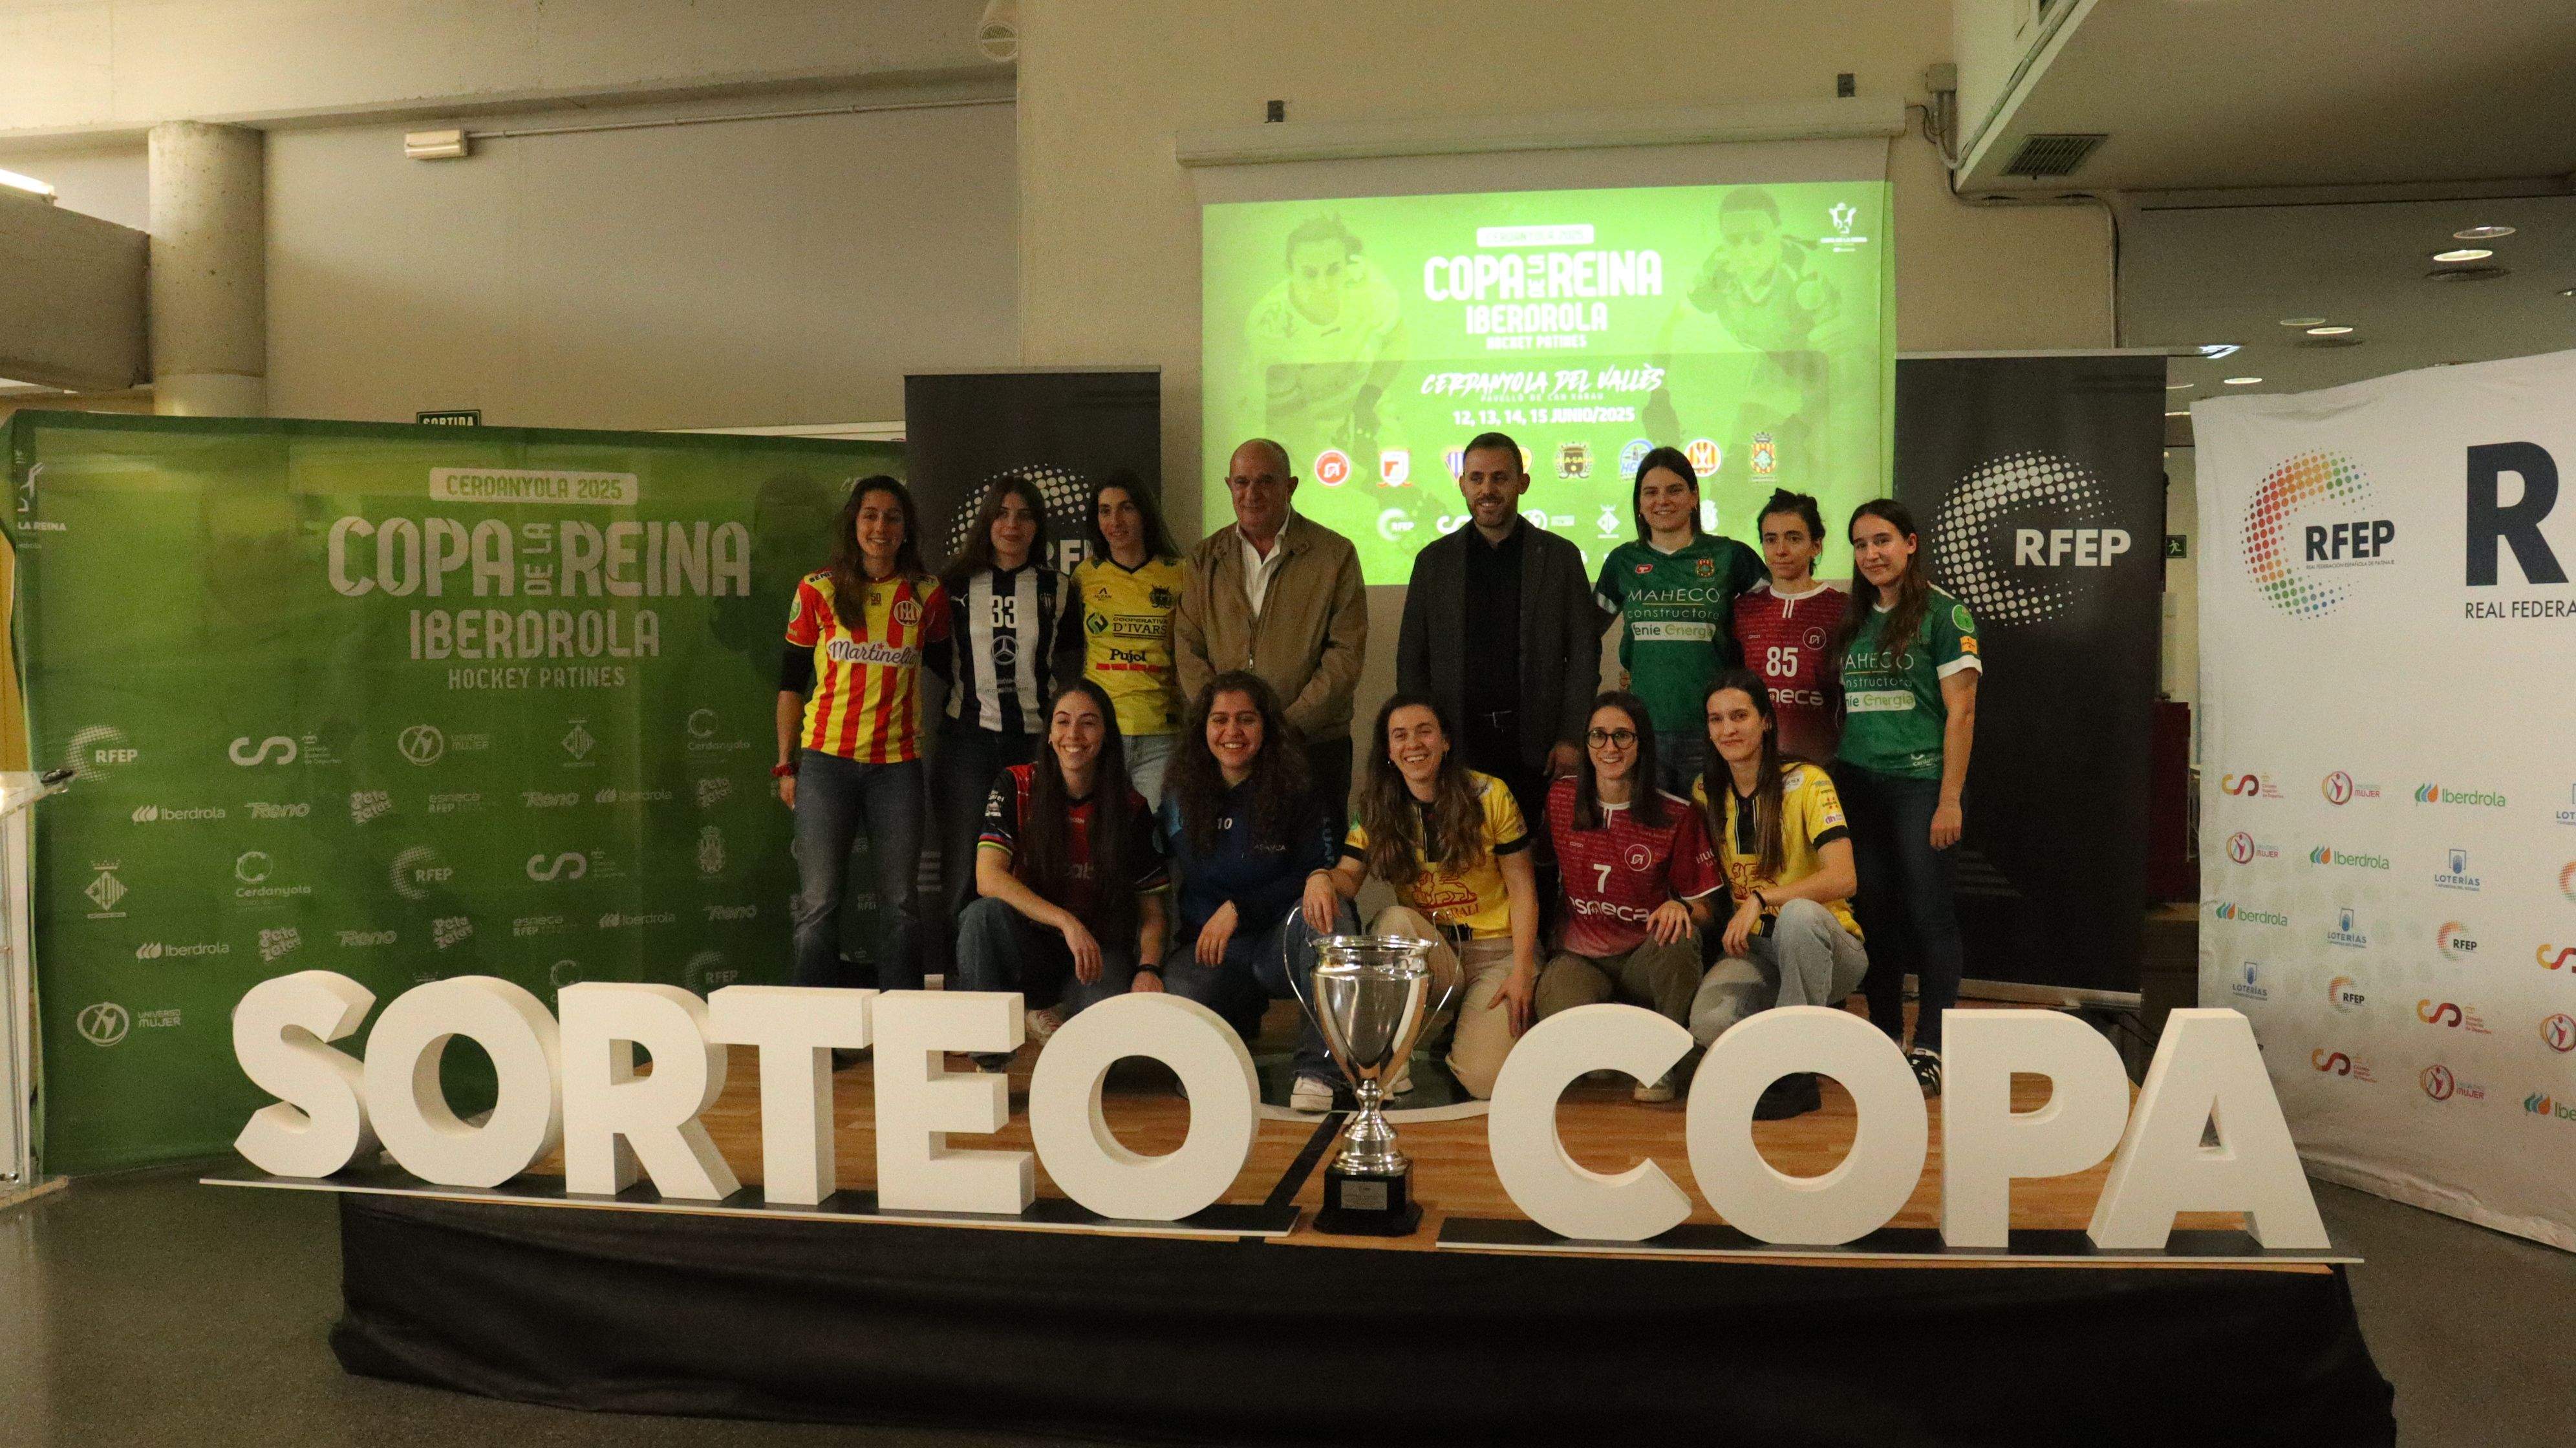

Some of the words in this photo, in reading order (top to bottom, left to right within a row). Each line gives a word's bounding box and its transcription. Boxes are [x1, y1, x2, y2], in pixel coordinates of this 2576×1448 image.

[1424, 253, 1525, 301] COPA
[1548, 250, 1662, 298] REINA
[1466, 302, 1607, 334] IBERDROLA
[1421, 372, 1548, 398] CERDANYOLA
[1553, 369, 1592, 396] DEL
[1597, 363, 1665, 392] VALLÈS
[1453, 410, 1476, 427] 12,
[1478, 409, 1501, 427] 13,
[1503, 409, 1527, 425] 14,
[1530, 408, 1548, 423] 15
[1550, 406, 1635, 424] JUNIO/2025
[445, 474, 568, 498] CERDANYOLA
[577, 478, 623, 500] 2025
[522, 522, 553, 554] LA
[2015, 529, 2132, 567] RFEP
[2306, 520, 2395, 561] RFEP
[328, 515, 515, 597] COPA
[560, 520, 751, 597] REINA
[523, 564, 553, 597] DE
[1628, 588, 1720, 602] MAHECO
[991, 595, 1018, 629] 33
[1627, 608, 1720, 621] constructora
[2465, 601, 2506, 619] REAL
[410, 609, 660, 660] IBERDROLA
[1633, 624, 1661, 636] enie
[1109, 648, 1146, 663] Pujol
[1766, 646, 1799, 677] 85
[449, 667, 530, 690] HOCKEY
[539, 666, 626, 689] PATINES
[1767, 687, 1824, 706] neca
[95, 748, 138, 763] RFEP
[2442, 788, 2506, 807] Iberdrola
[160, 806, 226, 821] Iberdrola
[244, 802, 310, 820] Reno
[1216, 817, 1233, 830] 10
[2334, 851, 2390, 869] Iberdrola
[1593, 863, 1612, 894] 7
[2434, 874, 2480, 887] LOTERÍAS
[235, 884, 312, 899] Cerdanyola
[2237, 907, 2288, 926] Iberdrola
[165, 941, 230, 957] Iberdrola
[2453, 939, 2478, 951] RFEP
[2343, 992, 2365, 1005] RFEP
[232, 970, 1260, 1220] SORTEO
[1488, 1004, 2331, 1249] COPA
